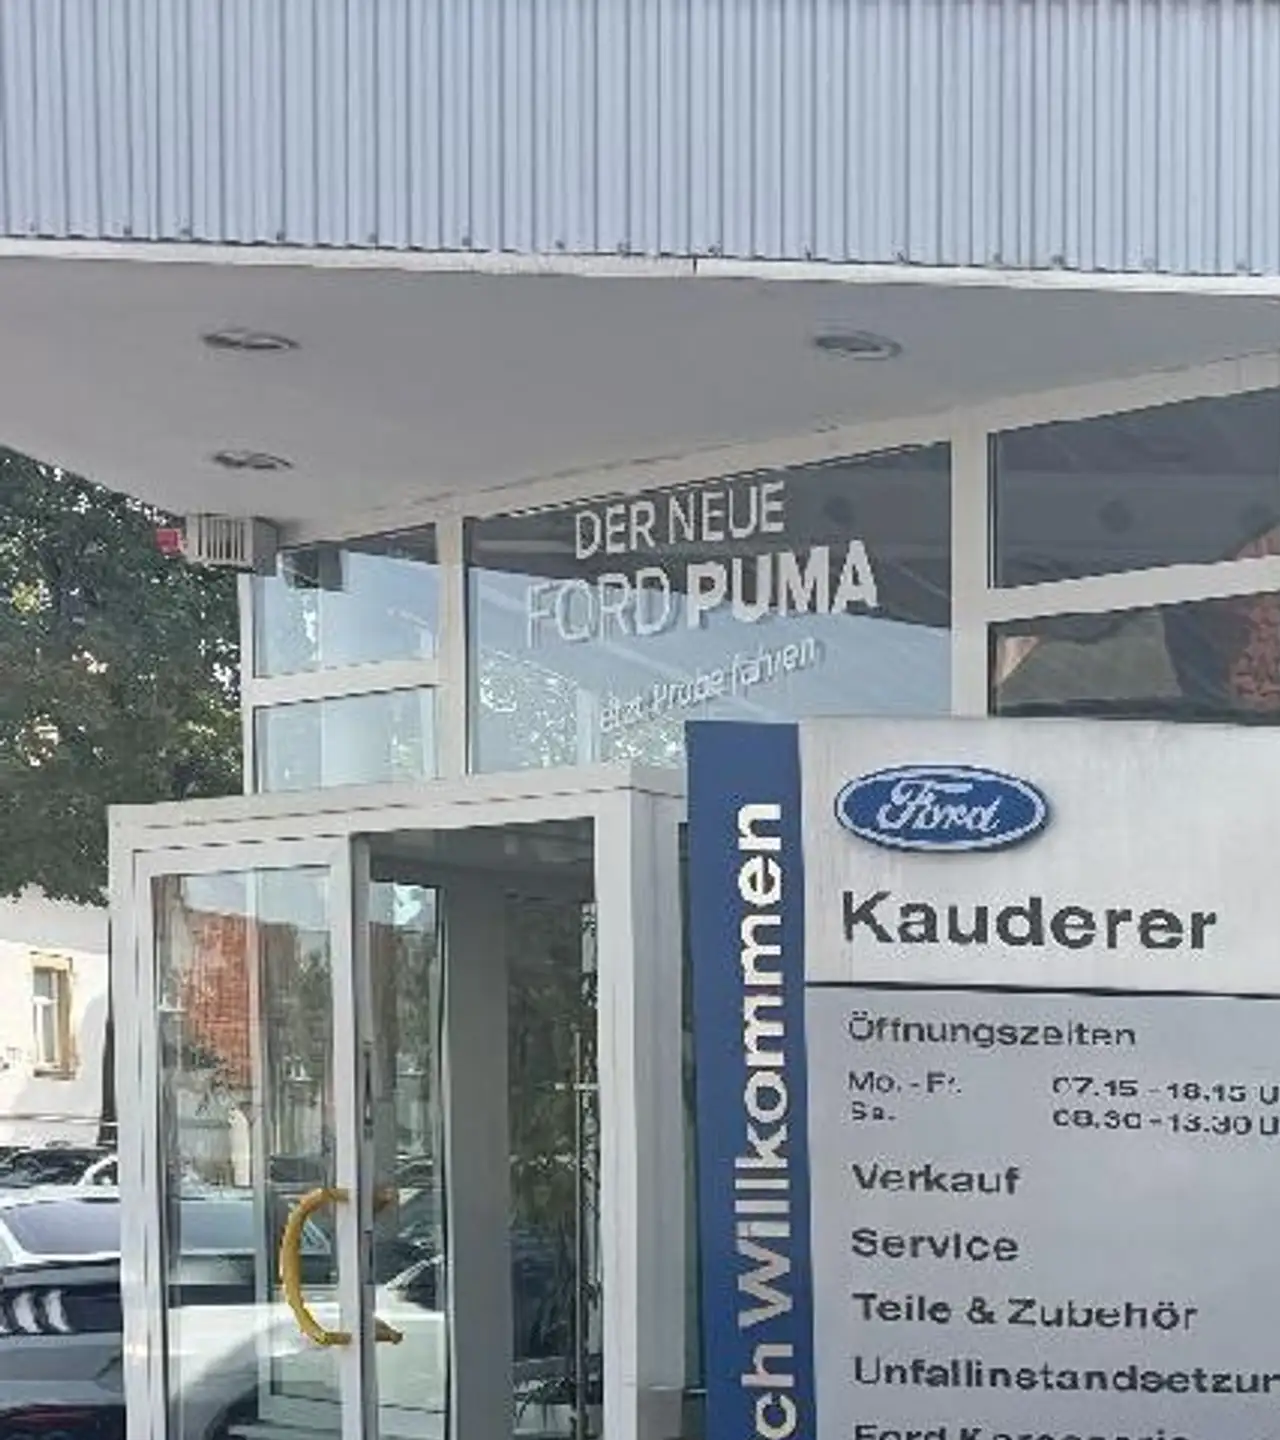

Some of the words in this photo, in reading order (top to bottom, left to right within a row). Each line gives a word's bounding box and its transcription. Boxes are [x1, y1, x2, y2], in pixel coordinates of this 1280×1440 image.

[575, 498, 656, 560] DER
[668, 480, 786, 546] NEUE
[526, 566, 672, 649] FORD
[685, 538, 880, 630] PUMA
[875, 779, 1003, 833] Ford
[841, 889, 1219, 951] Kauderer
[848, 1010, 1137, 1048] Öffnungszeiten
[735, 802, 793, 1330] Willkommen
[848, 1071, 902, 1094] Mo.
[850, 1100, 897, 1121] Sa.
[852, 1163, 1022, 1195] Verkauf
[851, 1227, 1020, 1262] Service
[852, 1293, 952, 1325] Teile
[966, 1296, 997, 1325] &
[1008, 1297, 1199, 1331] Zubehör
